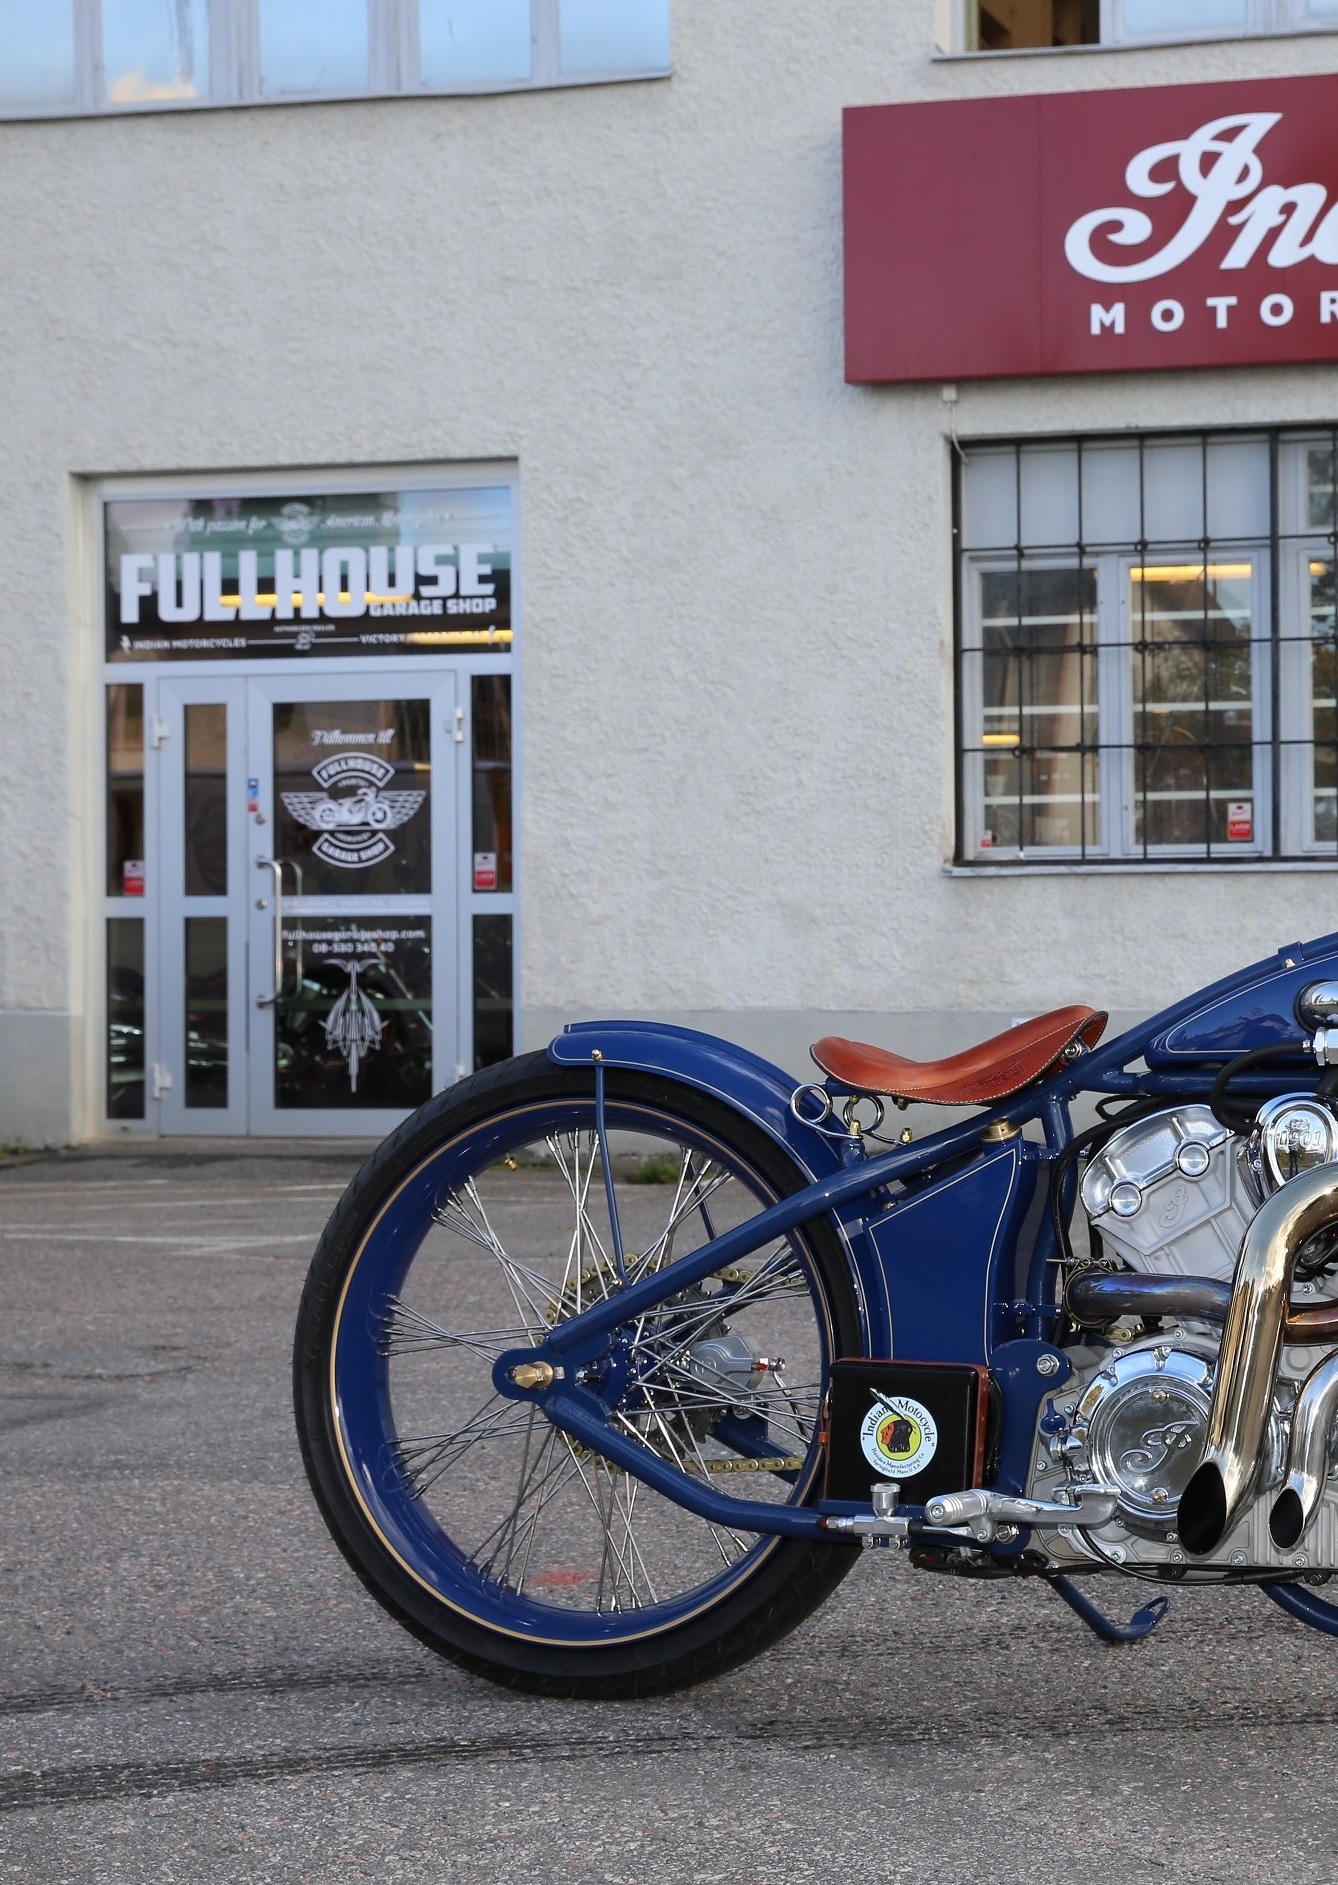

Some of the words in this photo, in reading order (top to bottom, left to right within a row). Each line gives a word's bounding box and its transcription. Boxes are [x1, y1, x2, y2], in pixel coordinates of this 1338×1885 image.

[120, 543, 496, 624] FULLHOUSE
[369, 600, 444, 617] GARAGE
[446, 597, 497, 614] SHOP
[132, 640, 171, 651] INDIAN
[172, 637, 248, 650] MOTORCYCLES
[359, 633, 405, 645] VICTORY
[1275, 1130, 1322, 1148] 1901
